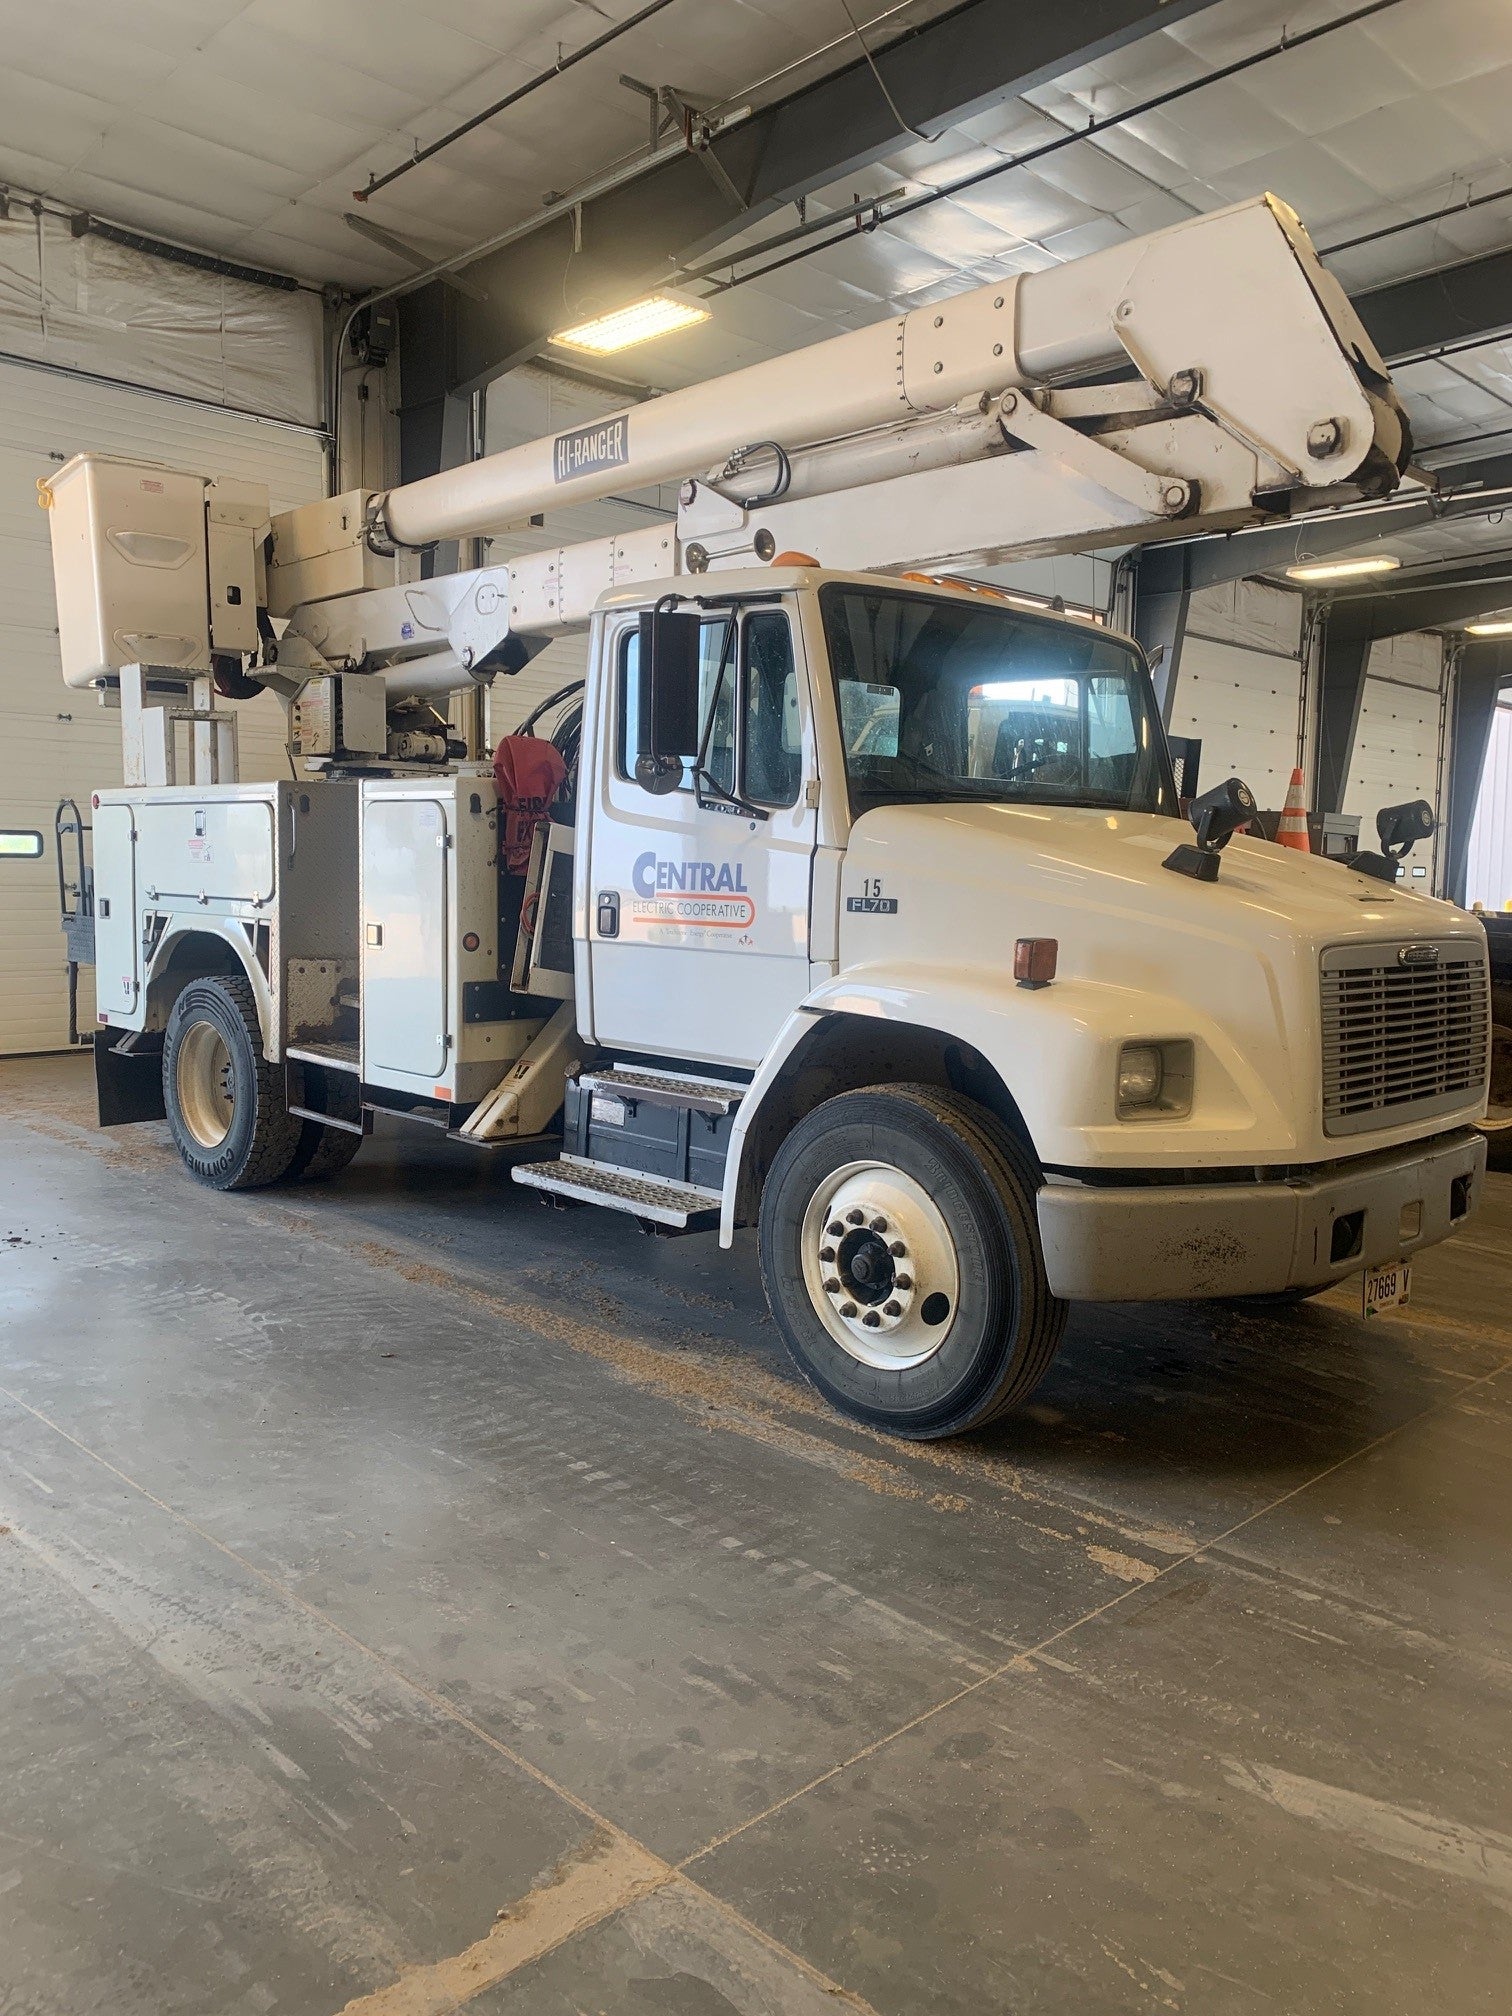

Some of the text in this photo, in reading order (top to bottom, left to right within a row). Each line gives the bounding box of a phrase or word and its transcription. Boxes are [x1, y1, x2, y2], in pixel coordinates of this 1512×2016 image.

[558, 420, 624, 480] HI-RANGER
[632, 851, 748, 899] CENTRAL
[863, 878, 882, 898] 15
[632, 901, 746, 918] ELECTRIC COOPERATIVE
[852, 898, 891, 912] FL70
[1367, 1269, 1409, 1304] 27669 V
